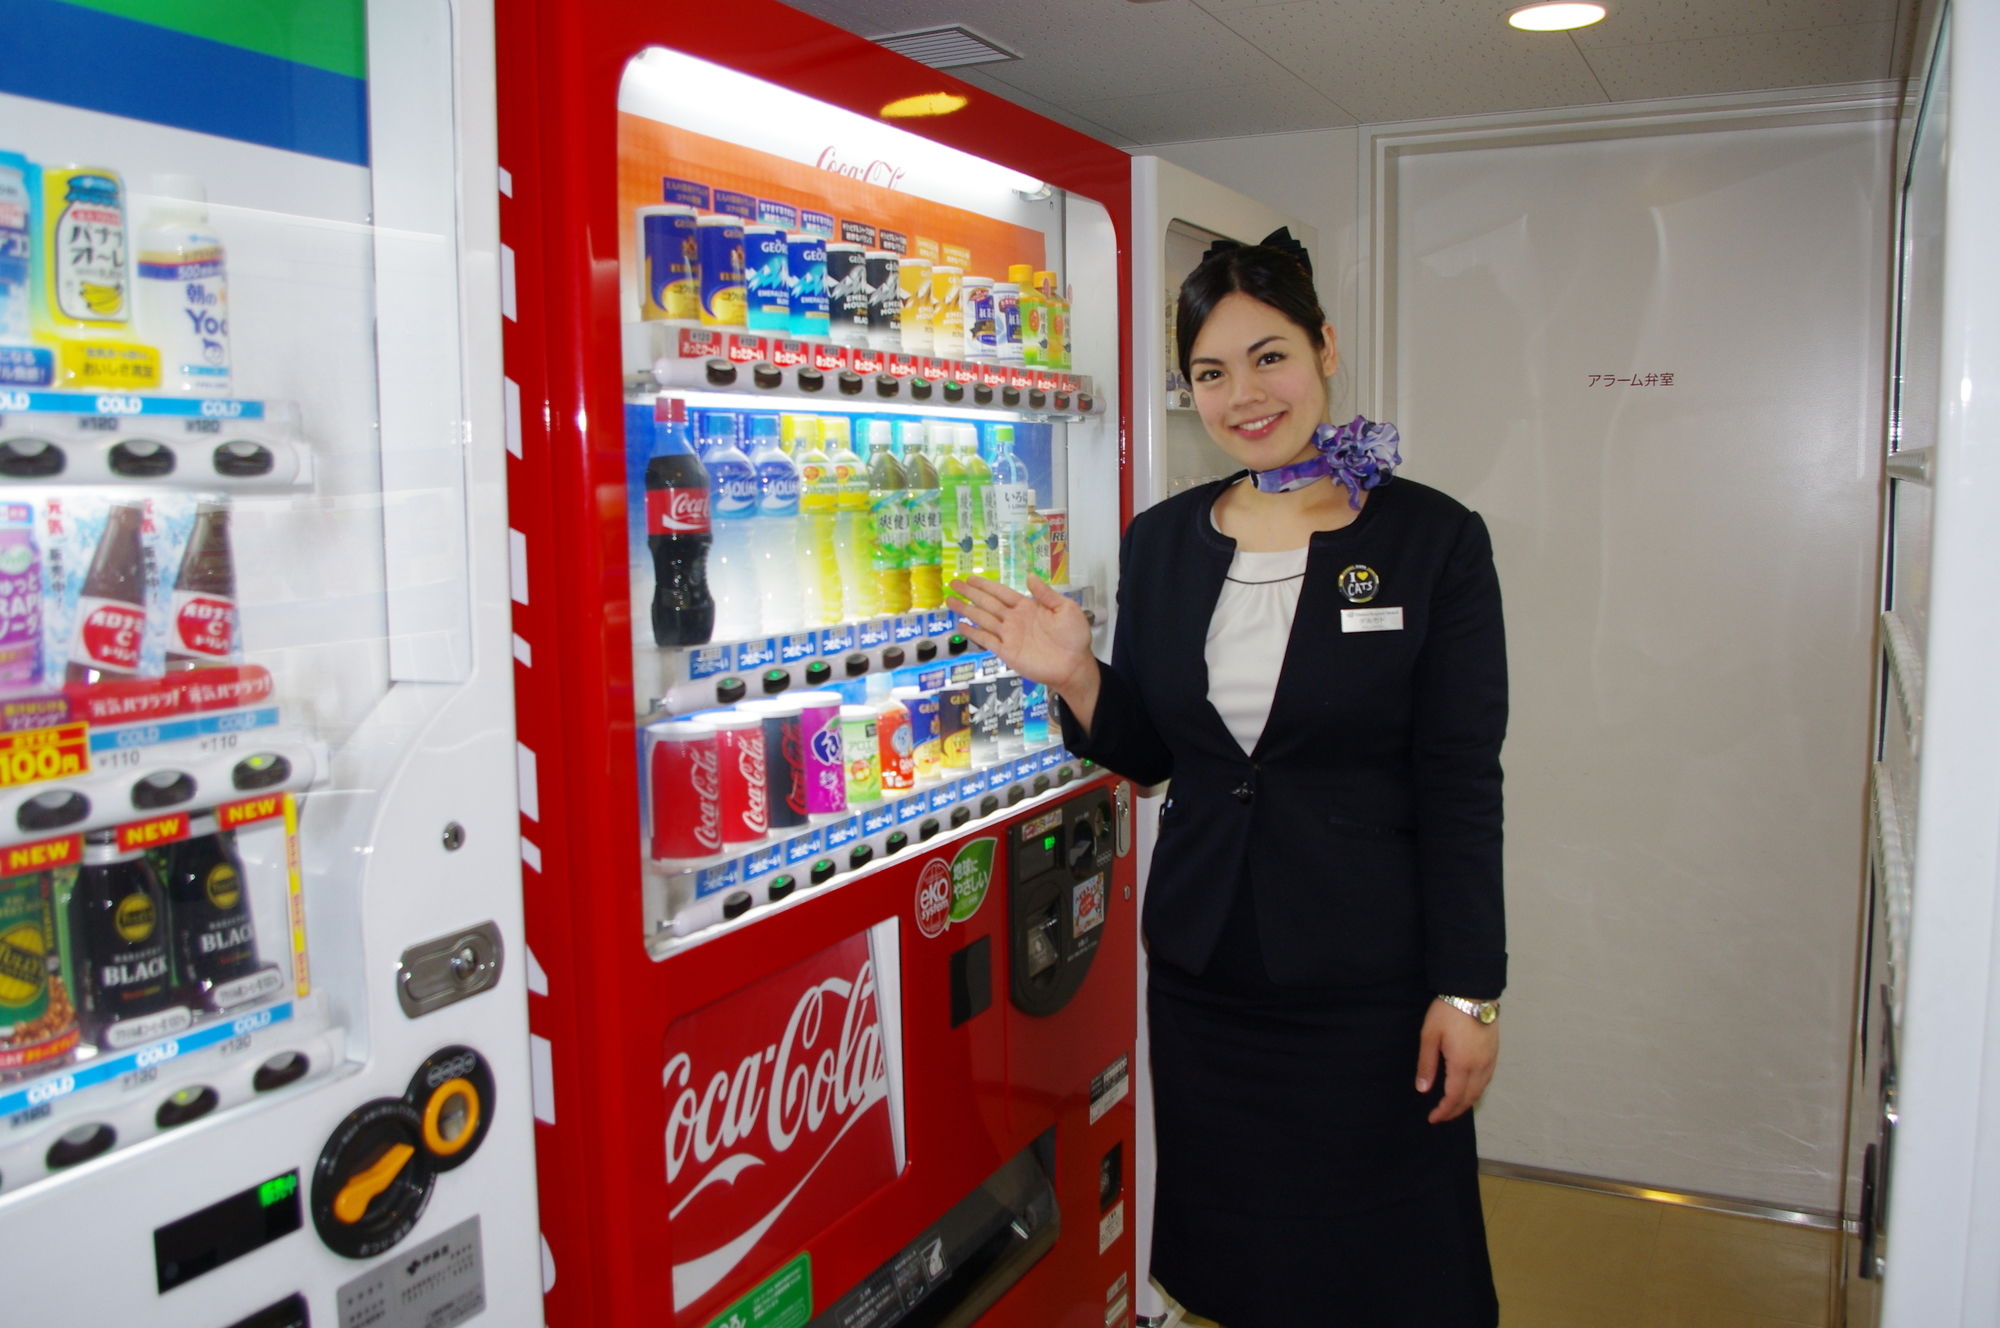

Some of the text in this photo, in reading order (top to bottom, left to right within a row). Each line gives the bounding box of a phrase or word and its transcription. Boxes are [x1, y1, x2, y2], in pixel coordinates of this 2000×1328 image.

[1588, 373, 1675, 388] アラーム弁室
[96, 397, 143, 414] COLD
[201, 400, 242, 417] COLD
[1347, 581, 1373, 596] CATS
[1349, 572, 1356, 583] I
[117, 727, 160, 745] COLD
[737, 734, 768, 833] Coca-Cola
[228, 797, 276, 824] NEW
[690, 747, 720, 849] Coca-Cola
[126, 818, 181, 846] NEW
[10, 840, 71, 869] NEW
[104, 954, 168, 988] BLACK
[234, 1011, 272, 1035] COLD
[136, 1040, 180, 1067] COLD
[27, 1074, 75, 1104] COLD
